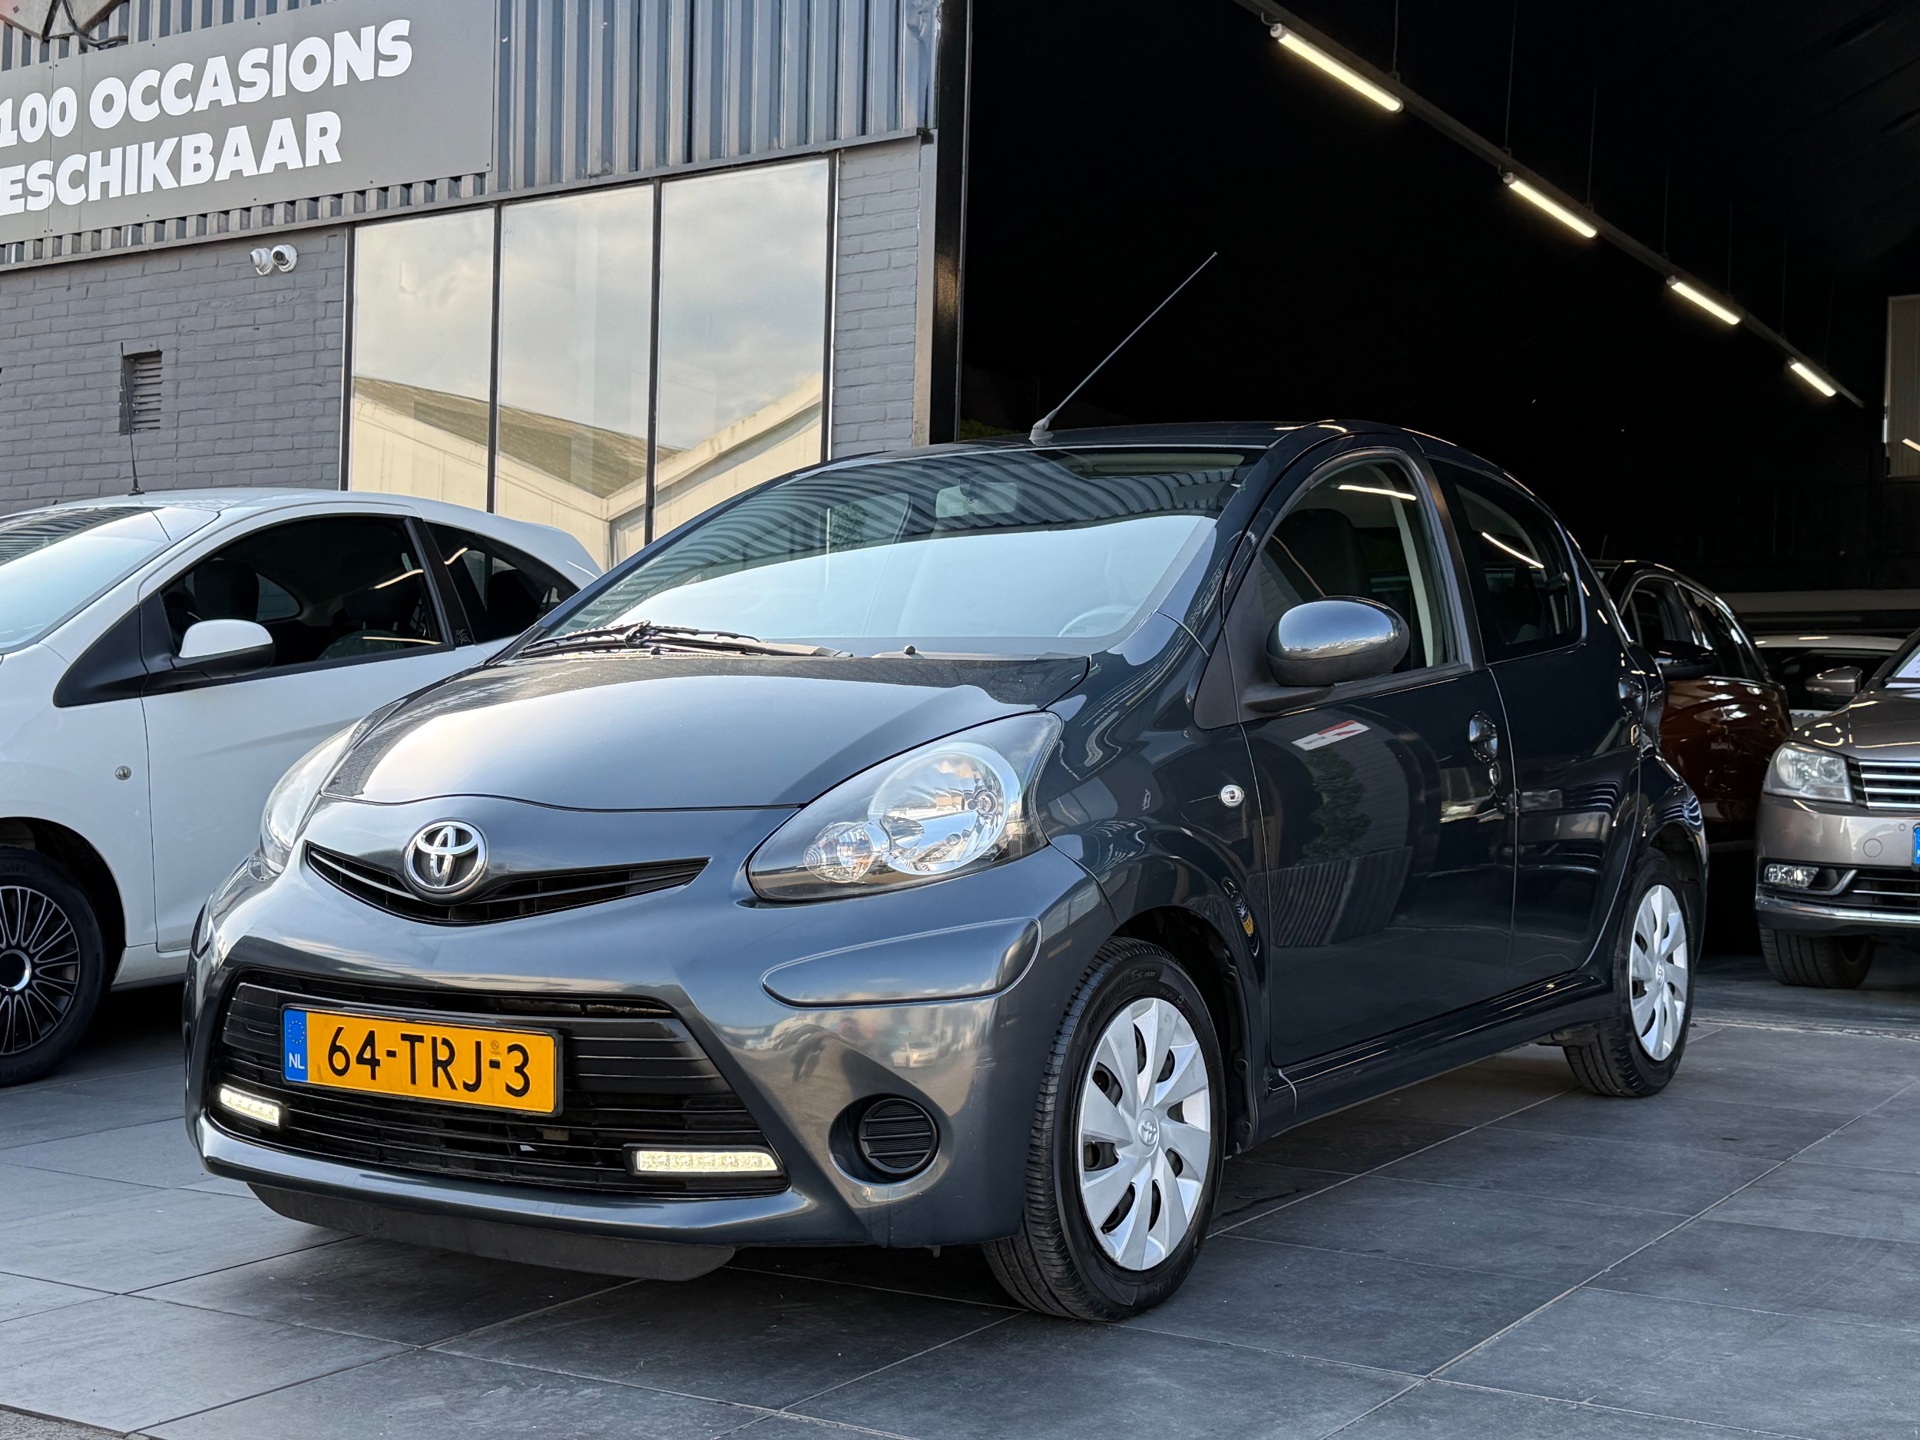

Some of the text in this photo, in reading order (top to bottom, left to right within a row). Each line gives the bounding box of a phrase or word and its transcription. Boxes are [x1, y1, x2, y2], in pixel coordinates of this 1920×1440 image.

[89, 19, 413, 129] OCCASIONS
[0, 110, 342, 216] ESCHIKBAAR
[288, 1052, 305, 1070] NL
[327, 1026, 531, 1098] 64-TRJ-3
